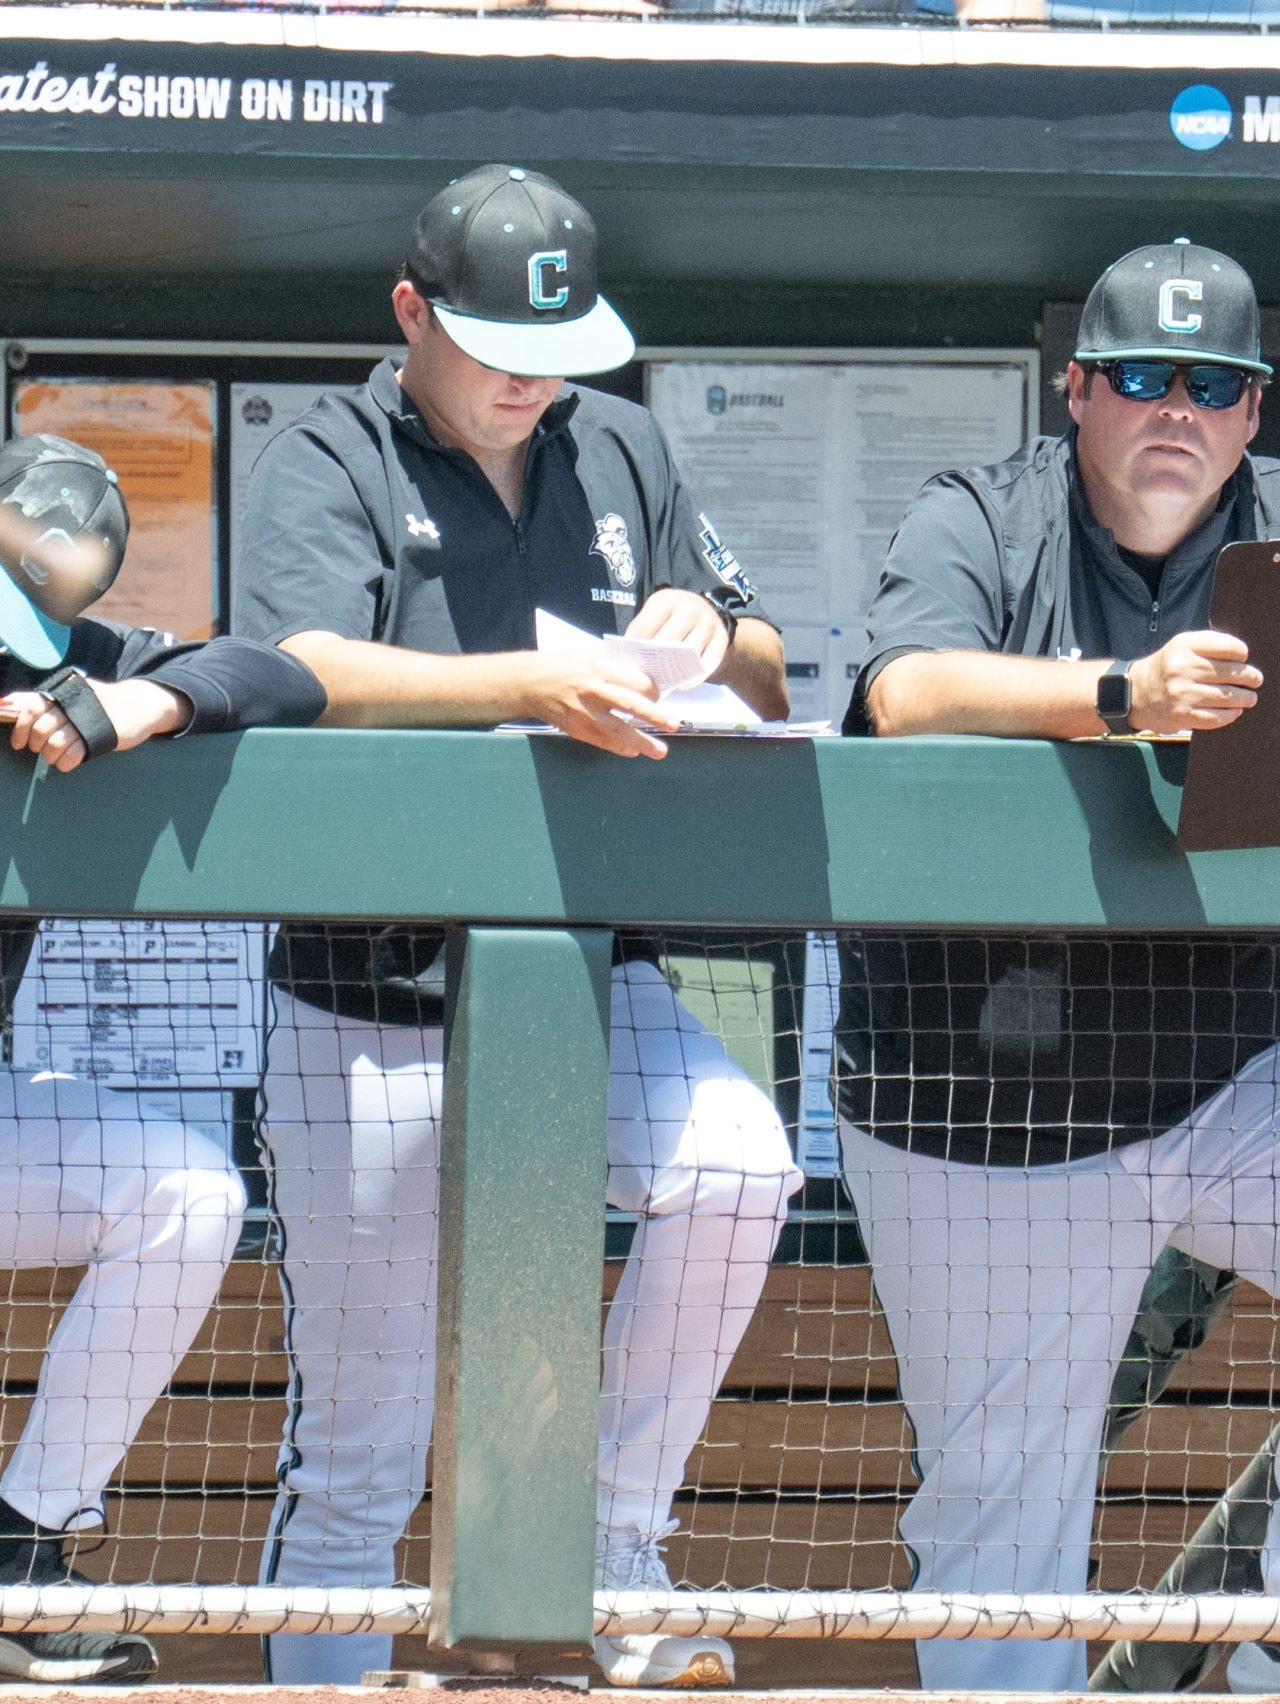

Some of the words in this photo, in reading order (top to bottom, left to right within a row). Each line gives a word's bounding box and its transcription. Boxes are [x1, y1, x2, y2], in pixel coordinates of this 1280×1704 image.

[117, 75, 231, 119] SHOW
[240, 78, 293, 121] ON
[303, 80, 391, 123] DIRT
[1175, 115, 1230, 135] NCAA
[528, 250, 569, 309] C
[1158, 279, 1202, 333] C
[591, 588, 637, 606] BASEBAL
[44, 940, 56, 953] P
[144, 940, 156, 953] P
